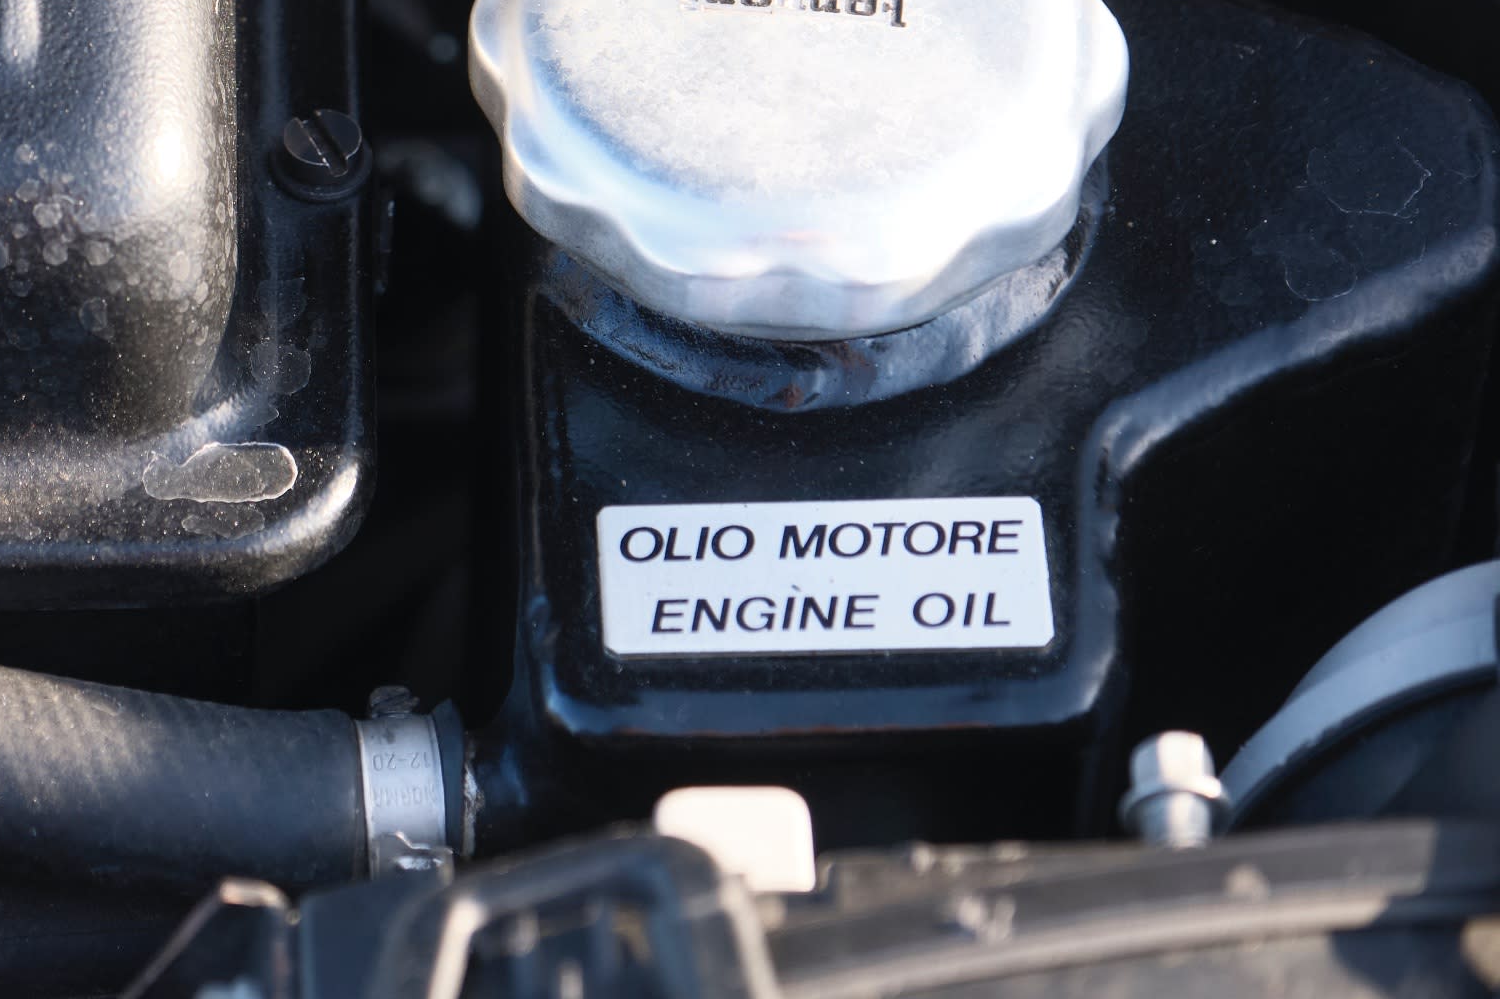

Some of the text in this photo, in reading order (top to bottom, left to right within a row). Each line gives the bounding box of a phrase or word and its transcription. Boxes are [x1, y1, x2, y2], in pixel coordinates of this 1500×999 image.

[619, 520, 1023, 562] OLIO MOTORE
[651, 592, 1011, 634] ENGINE OIL
